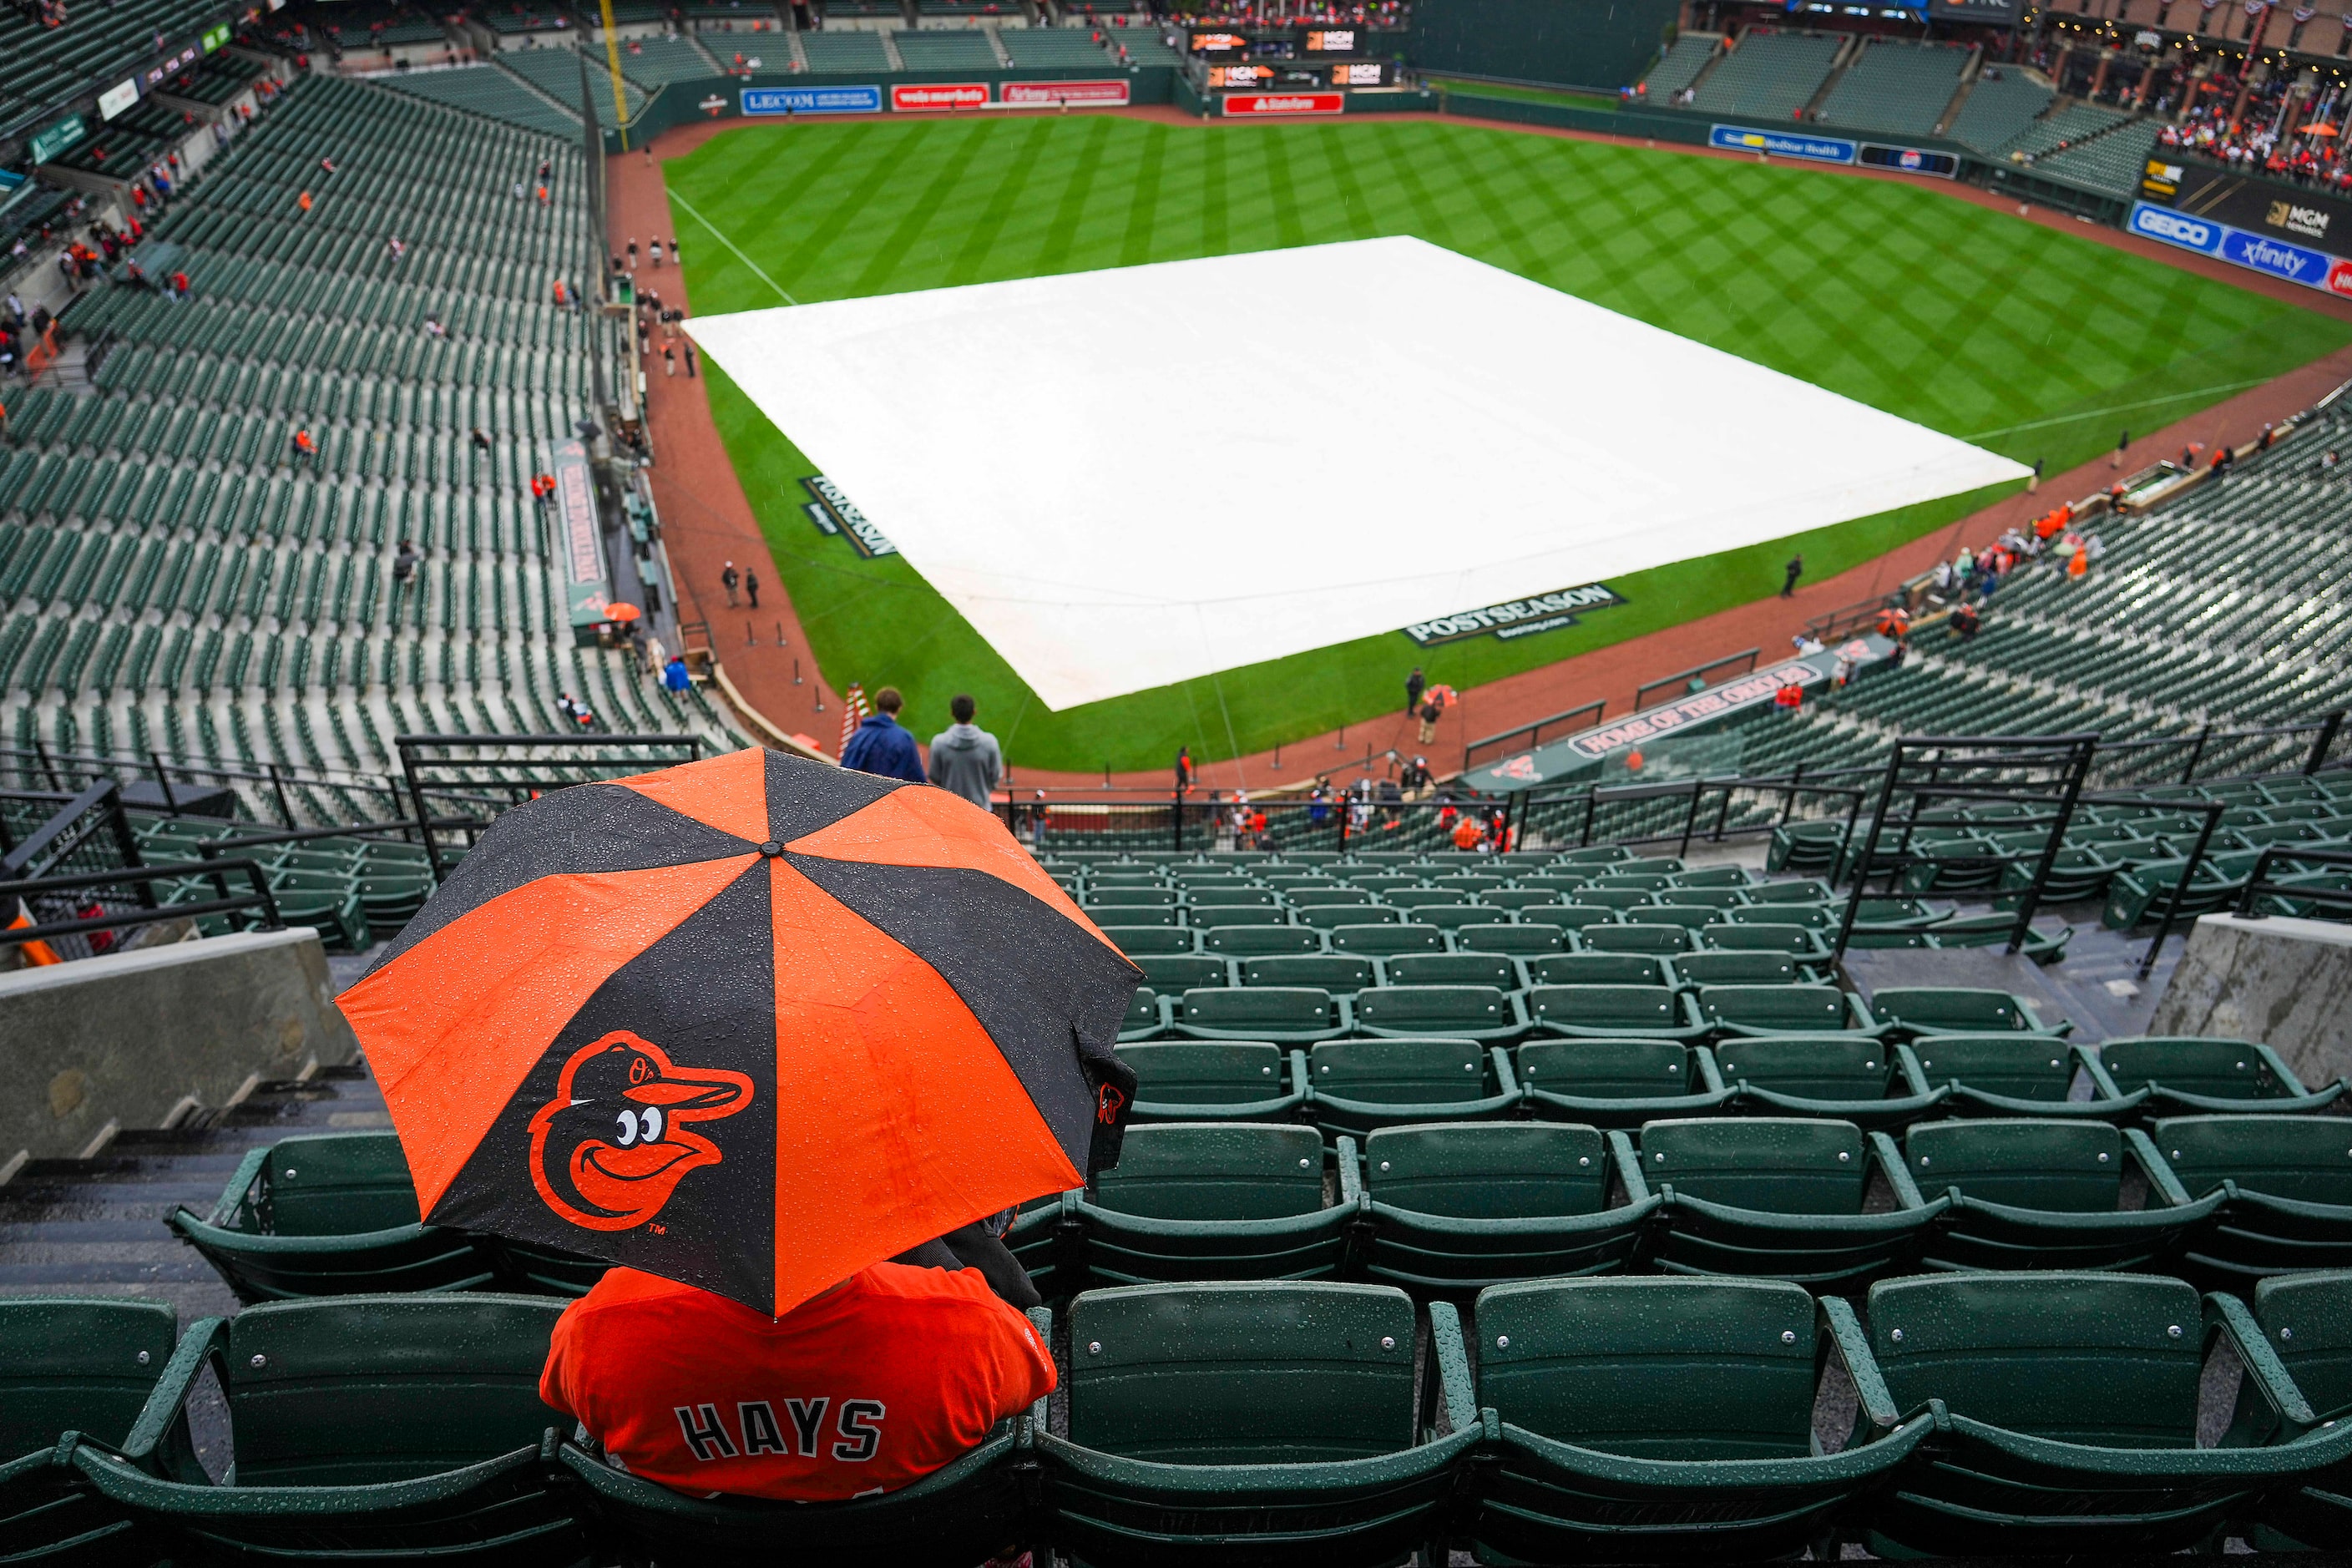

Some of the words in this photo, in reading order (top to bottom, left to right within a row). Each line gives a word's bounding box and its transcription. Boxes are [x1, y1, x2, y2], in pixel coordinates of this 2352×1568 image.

[750, 93, 815, 109] LECOM
[2137, 210, 2210, 246] GEICO
[2289, 205, 2330, 229] MGM
[2241, 240, 2309, 276] xfinity
[1406, 584, 1612, 641] POSTSEASON
[1580, 719, 1657, 753] HOME
[1651, 707, 1685, 729] OF
[1677, 694, 1729, 720] THE
[1721, 665, 1812, 704] ORIOLES
[630, 1057, 655, 1085] O's
[649, 1223, 667, 1236] TM
[674, 1397, 886, 1461] HAYS
